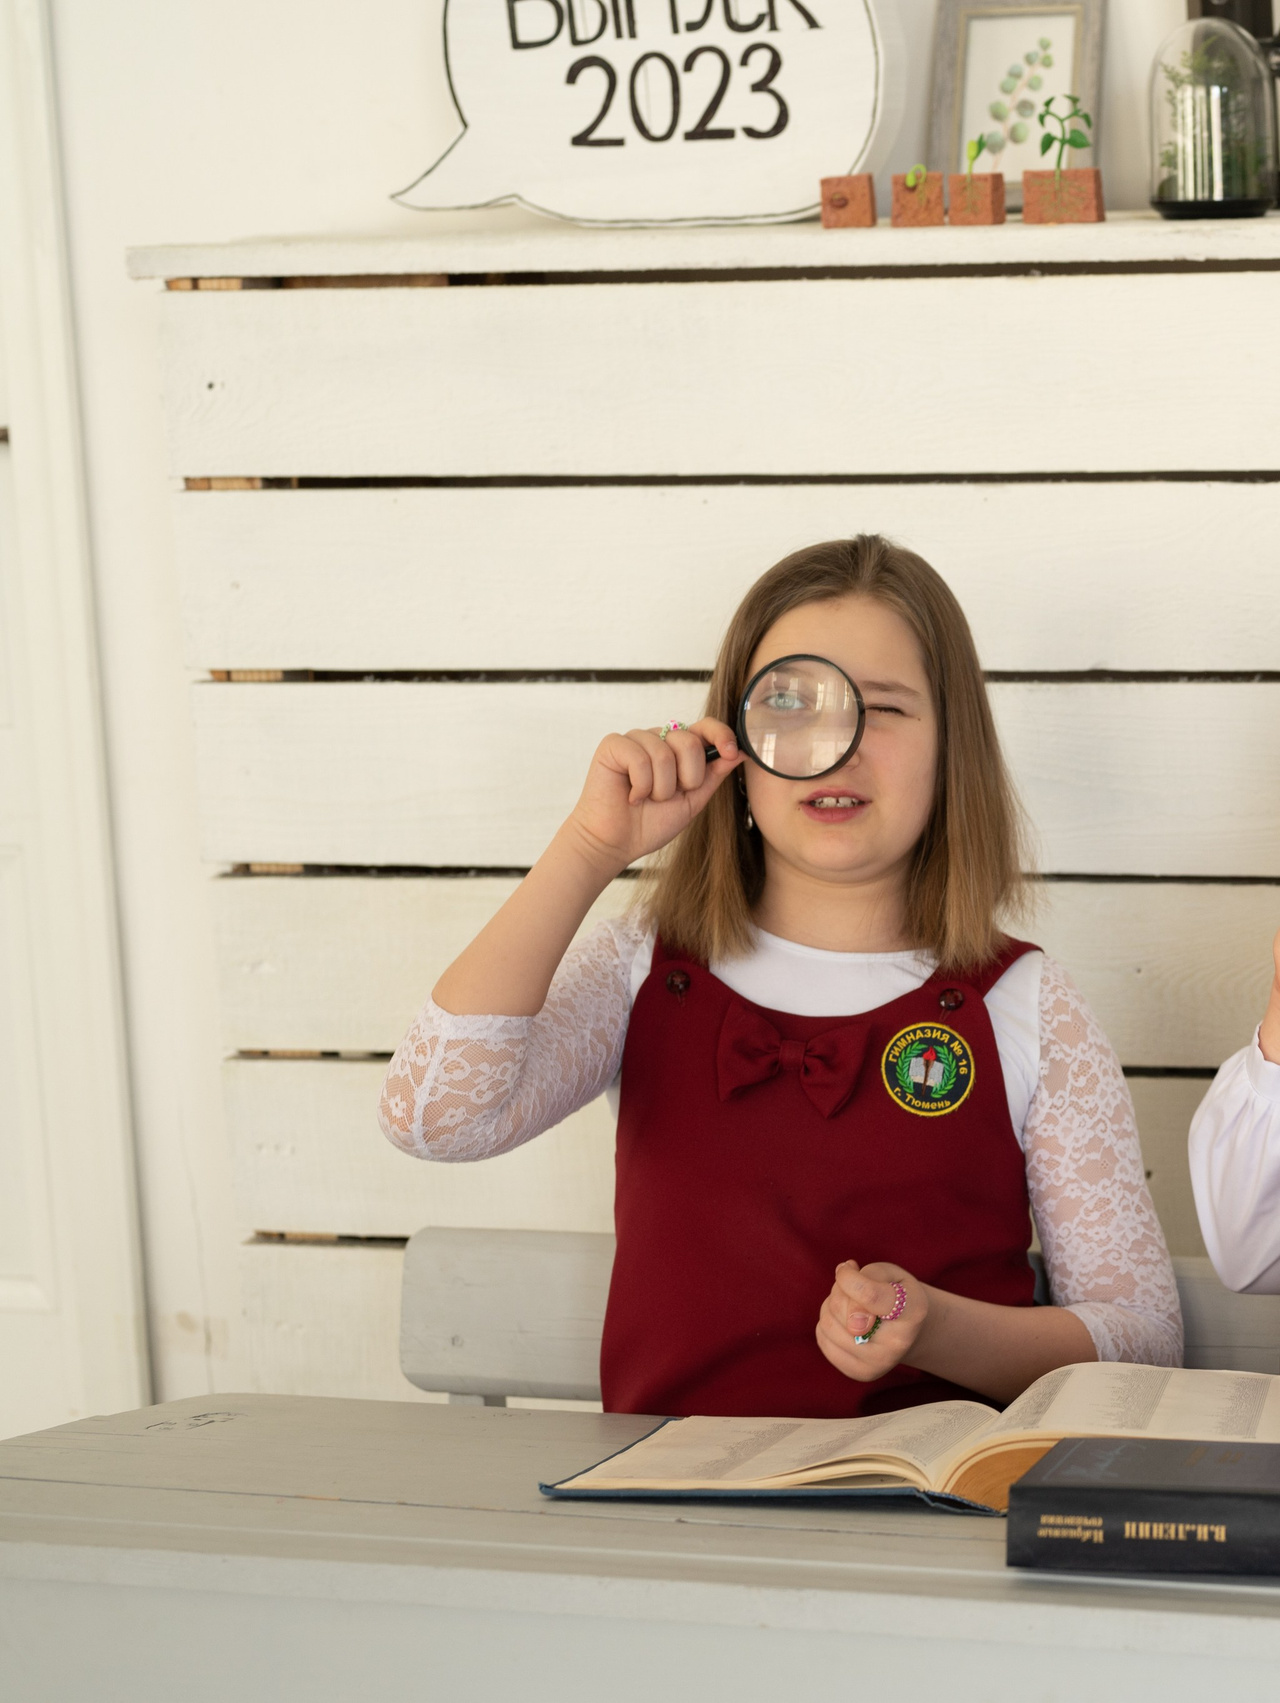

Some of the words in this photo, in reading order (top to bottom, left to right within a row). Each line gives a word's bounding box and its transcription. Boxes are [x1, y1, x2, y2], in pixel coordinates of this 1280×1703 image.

[565, 42, 790, 147] 2023
[888, 1028, 950, 1062] ГИМНАЗИЯ
[950, 1040, 964, 1056] №
[958, 1058, 968, 1075] 16
[893, 1087, 902, 1096] г.
[905, 1093, 951, 1110] Тюмень
